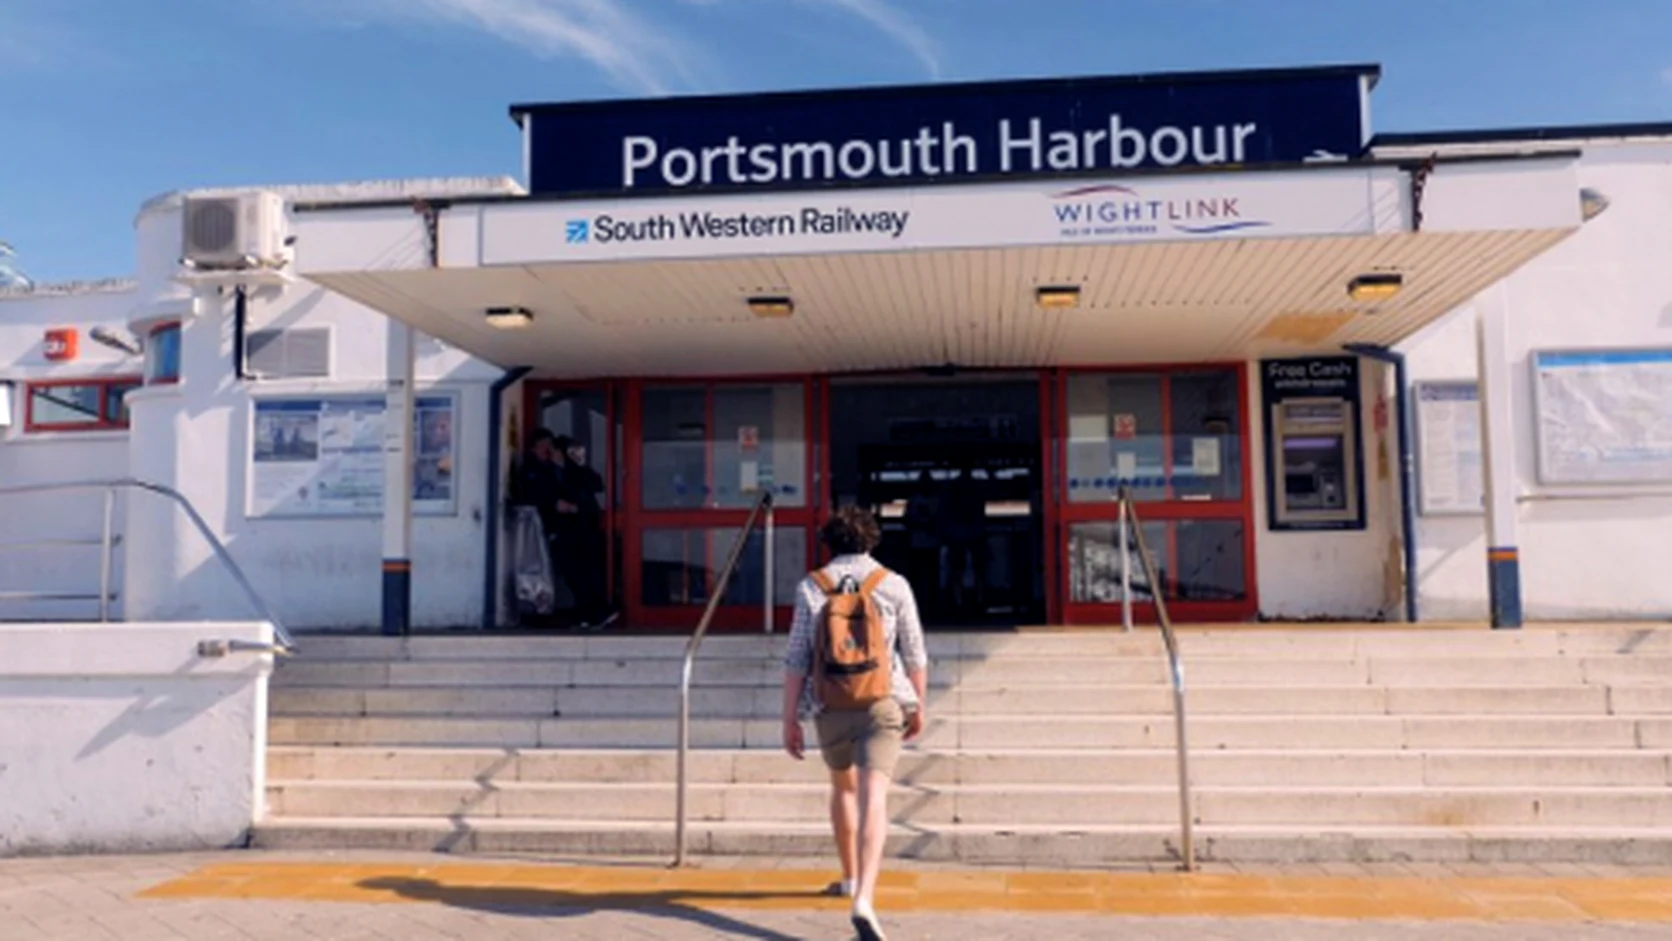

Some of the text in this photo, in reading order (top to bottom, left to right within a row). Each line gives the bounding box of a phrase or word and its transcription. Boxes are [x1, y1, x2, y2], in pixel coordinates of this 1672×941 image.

[622, 113, 1256, 187] Portsmouth Harbour
[594, 206, 909, 243] South Western Railway
[1055, 198, 1241, 223] WIGHTLINK
[1267, 361, 1352, 377] Free Cash
